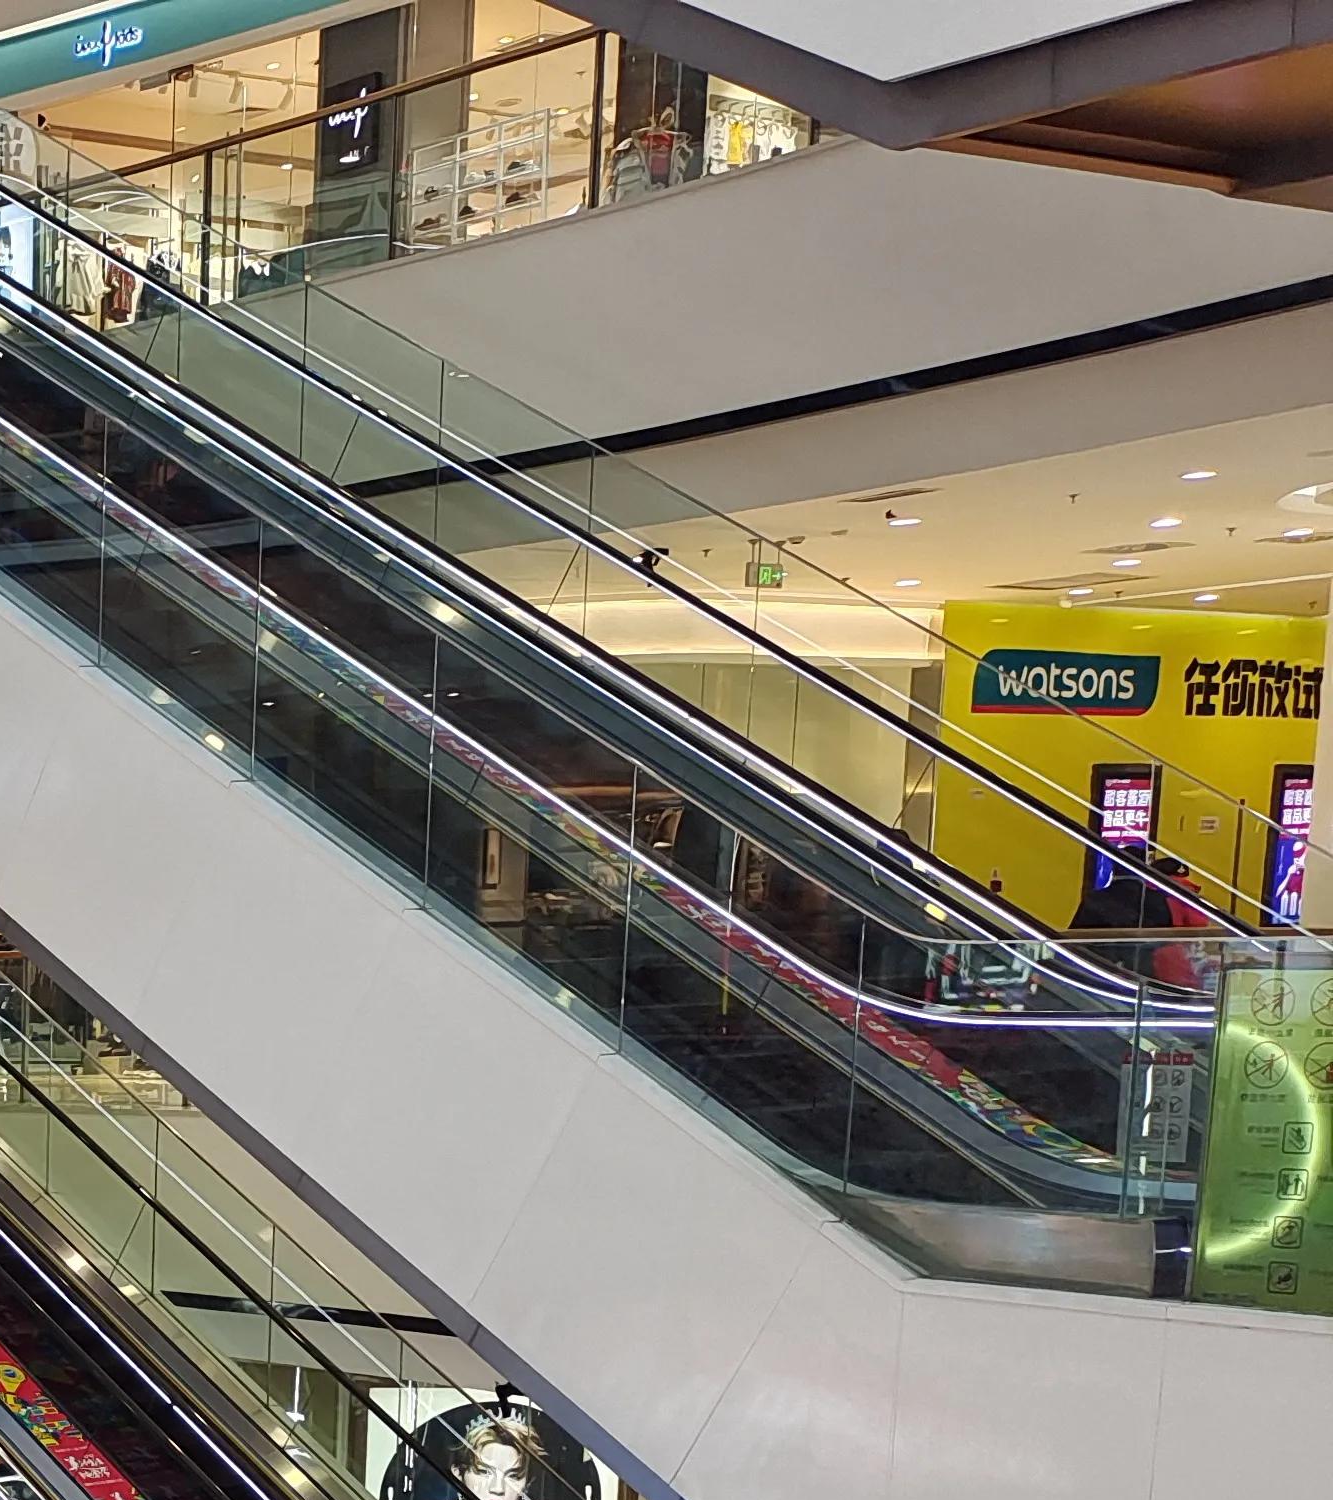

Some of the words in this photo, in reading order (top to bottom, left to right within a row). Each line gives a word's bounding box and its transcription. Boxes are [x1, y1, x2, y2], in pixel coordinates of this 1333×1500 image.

[998, 664, 1134, 700] watsons
[1185, 657, 1324, 719] 任你放试
